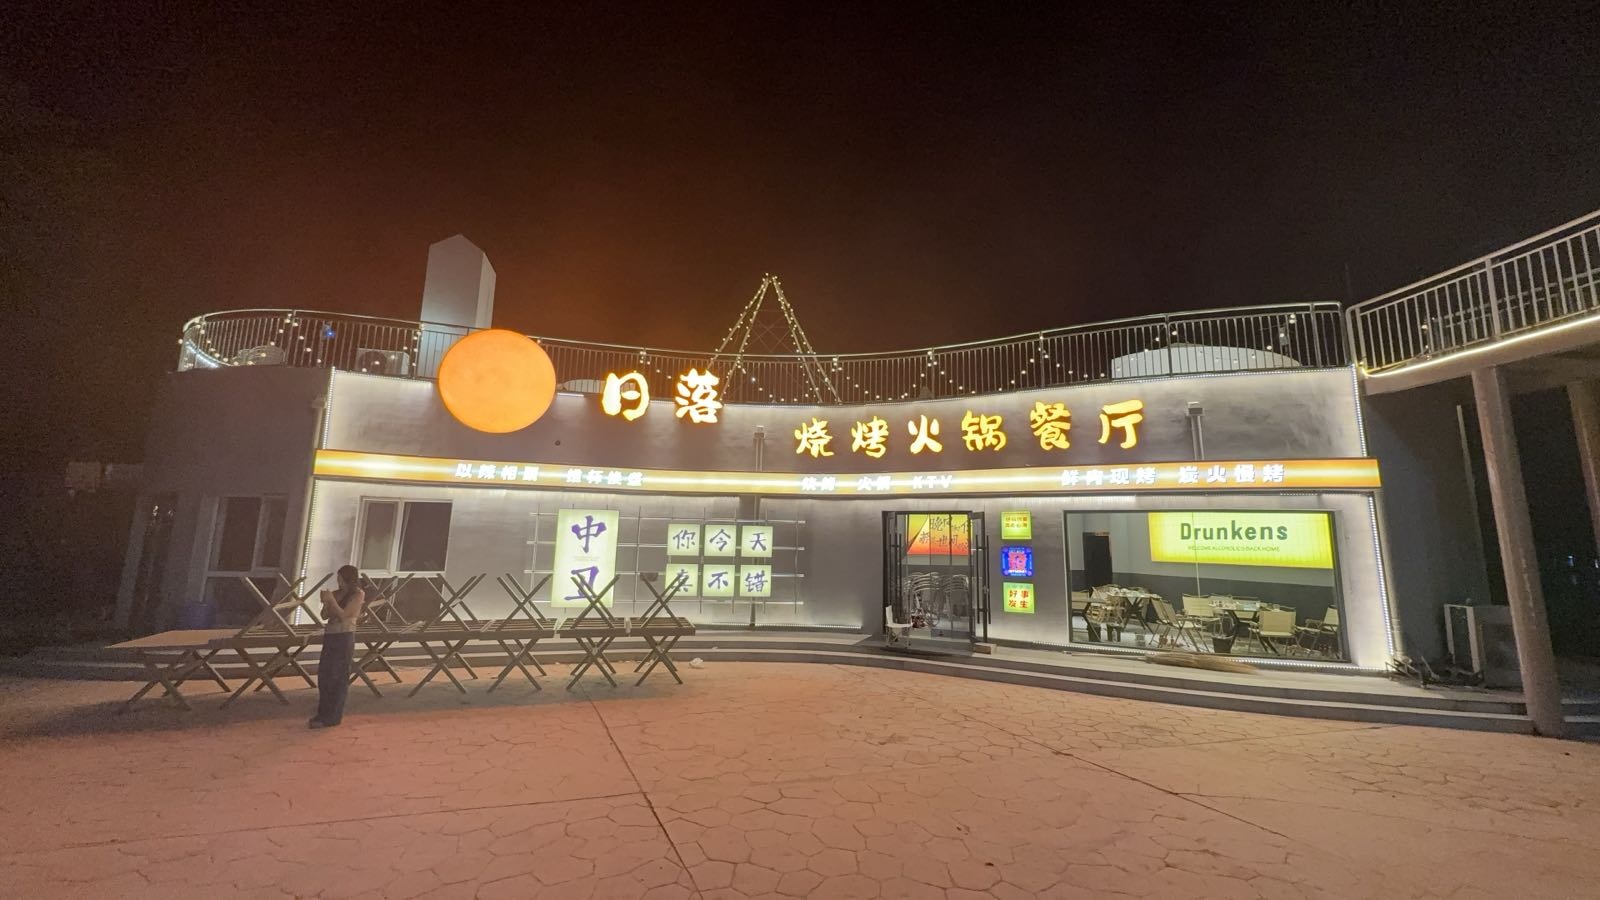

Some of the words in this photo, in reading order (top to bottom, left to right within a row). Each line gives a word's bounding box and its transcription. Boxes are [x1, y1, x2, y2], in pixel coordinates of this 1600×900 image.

[602, 368, 724, 424] 日落
[794, 399, 1144, 458] 烧烤火锅餐厅
[912, 474, 953, 489] KTV
[1061, 466, 1156, 485] 鲜肉现烤
[1178, 463, 1284, 483] 炭火慢烤
[672, 528, 768, 552] 你今天
[1181, 520, 1288, 541] Drunkens
[671, 568, 769, 593] 真不错
[1008, 599, 1029, 609] 发生
[1009, 589, 1029, 599] 好事
